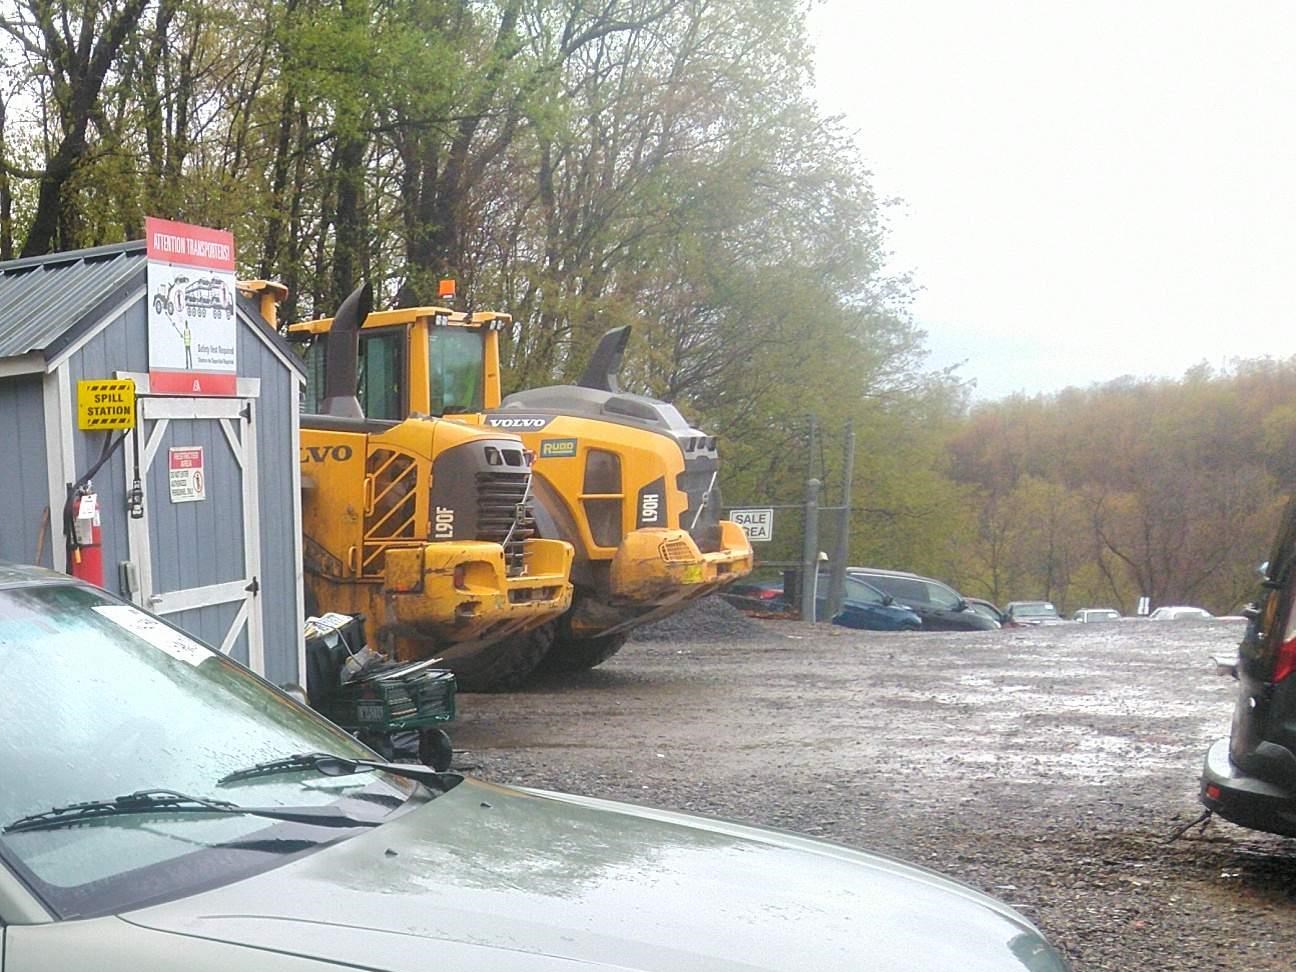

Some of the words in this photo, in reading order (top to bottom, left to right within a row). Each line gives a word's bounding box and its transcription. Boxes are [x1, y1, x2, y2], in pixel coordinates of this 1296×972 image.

[153, 232, 185, 253] ATTENTION
[94, 393, 123, 403] SPILL
[87, 406, 131, 416] STATION
[489, 419, 546, 427] VOLVO
[641, 494, 659, 522] L90H
[435, 506, 454, 538] L90F
[735, 513, 767, 524] SALE
[743, 526, 766, 537] REA
